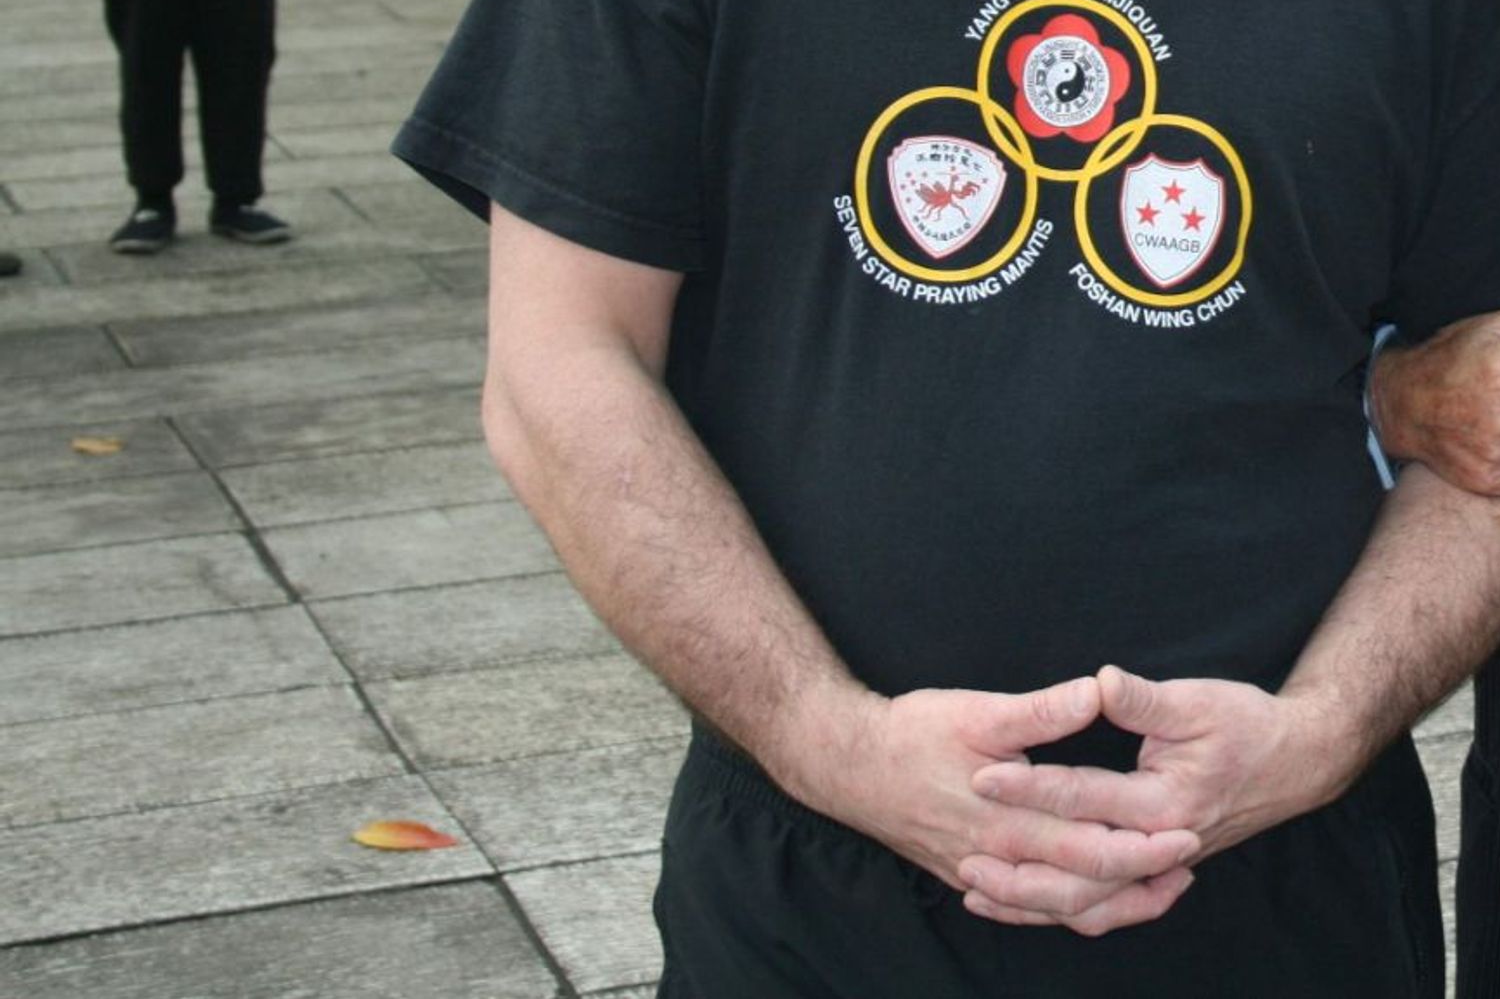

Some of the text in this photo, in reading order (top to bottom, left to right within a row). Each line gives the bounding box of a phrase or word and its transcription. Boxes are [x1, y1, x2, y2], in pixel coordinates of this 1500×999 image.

[834, 195, 868, 260] SEVEN
[862, 257, 912, 296] STAR
[913, 277, 1002, 305] PRAYING
[1002, 218, 1054, 285] MANTIS
[1134, 233, 1201, 253] CWAAGB
[1069, 263, 1246, 328] FOSHAN WING CHUN
